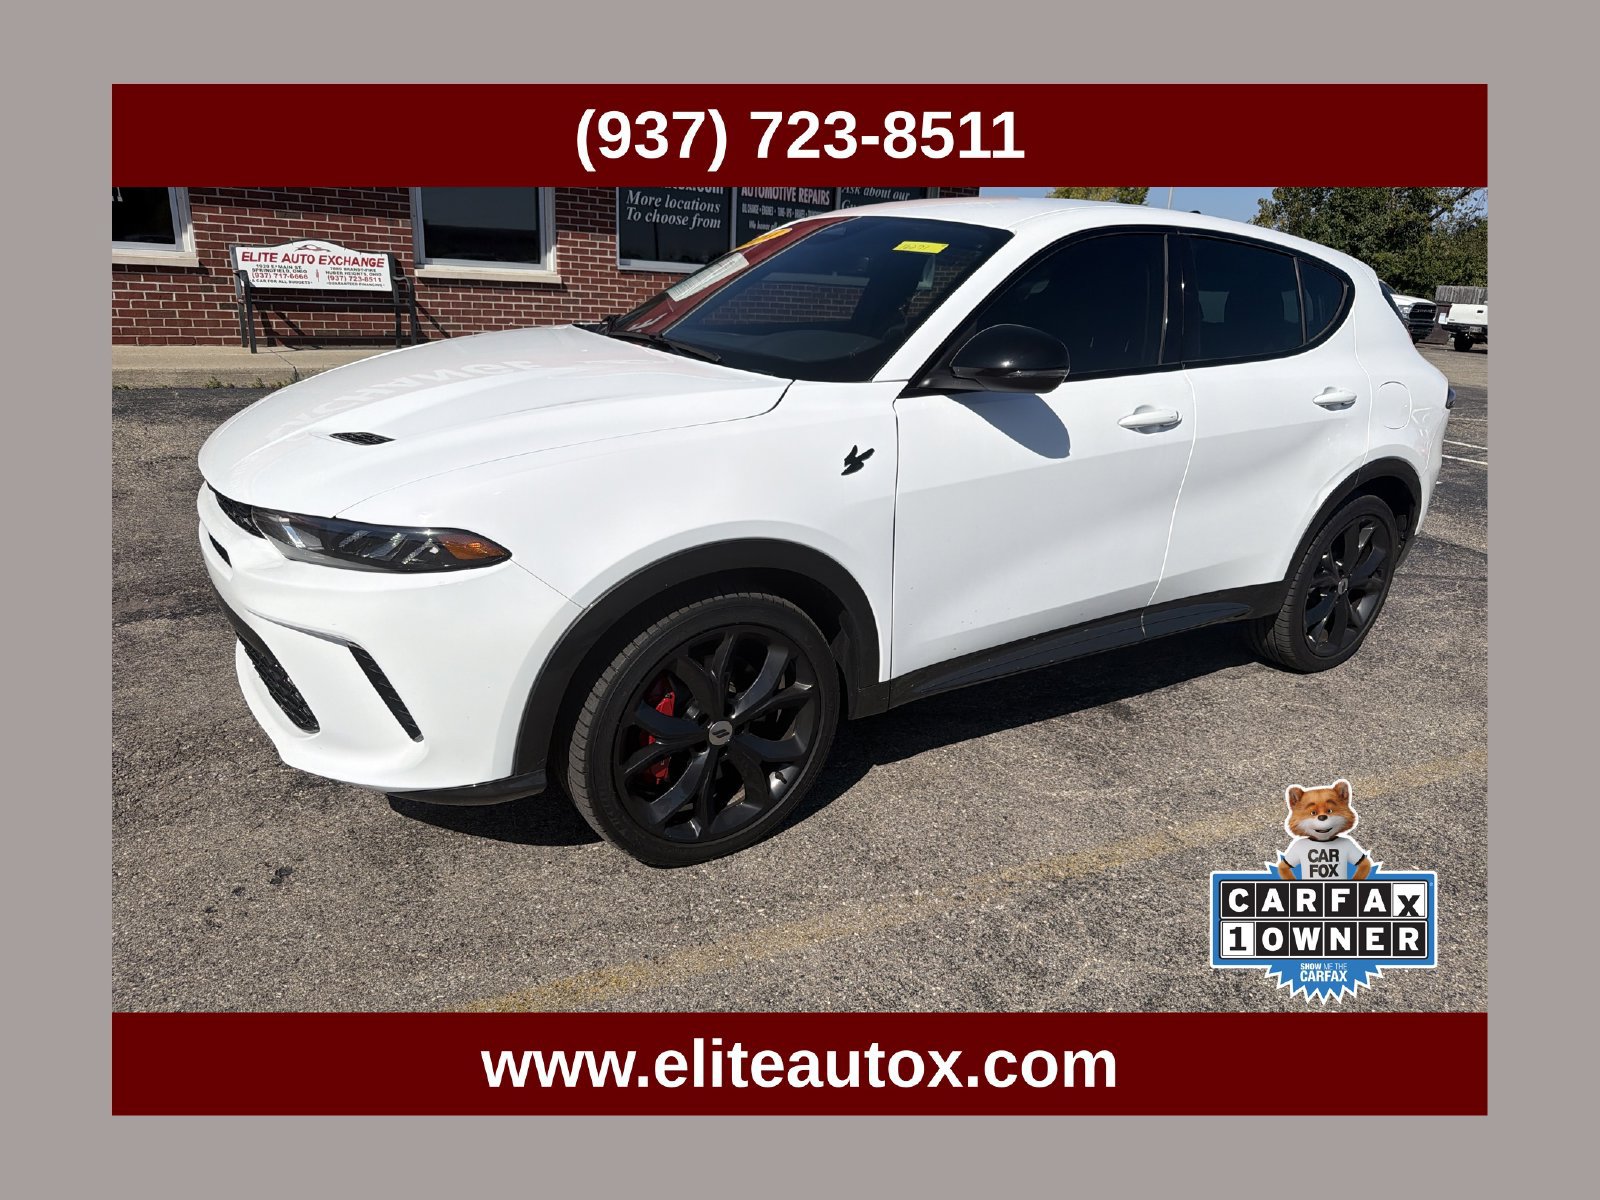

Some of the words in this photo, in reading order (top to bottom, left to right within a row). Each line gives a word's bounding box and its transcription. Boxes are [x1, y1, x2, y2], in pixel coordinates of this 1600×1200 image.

[626, 190, 662, 208] More
[664, 194, 721, 214] locations
[741, 187, 797, 203] AUTOMOTIVE
[798, 187, 830, 206] REPAIRS
[863, 187, 892, 199] about
[893, 191, 911, 201] our
[626, 206, 642, 222] To
[645, 208, 689, 226] choose
[689, 213, 721, 230] from
[241, 251, 279, 263] ELITE
[281, 252, 316, 265] AUTO
[318, 255, 385, 268] EXCHANGE
[348, 275, 382, 283] 723-8511
